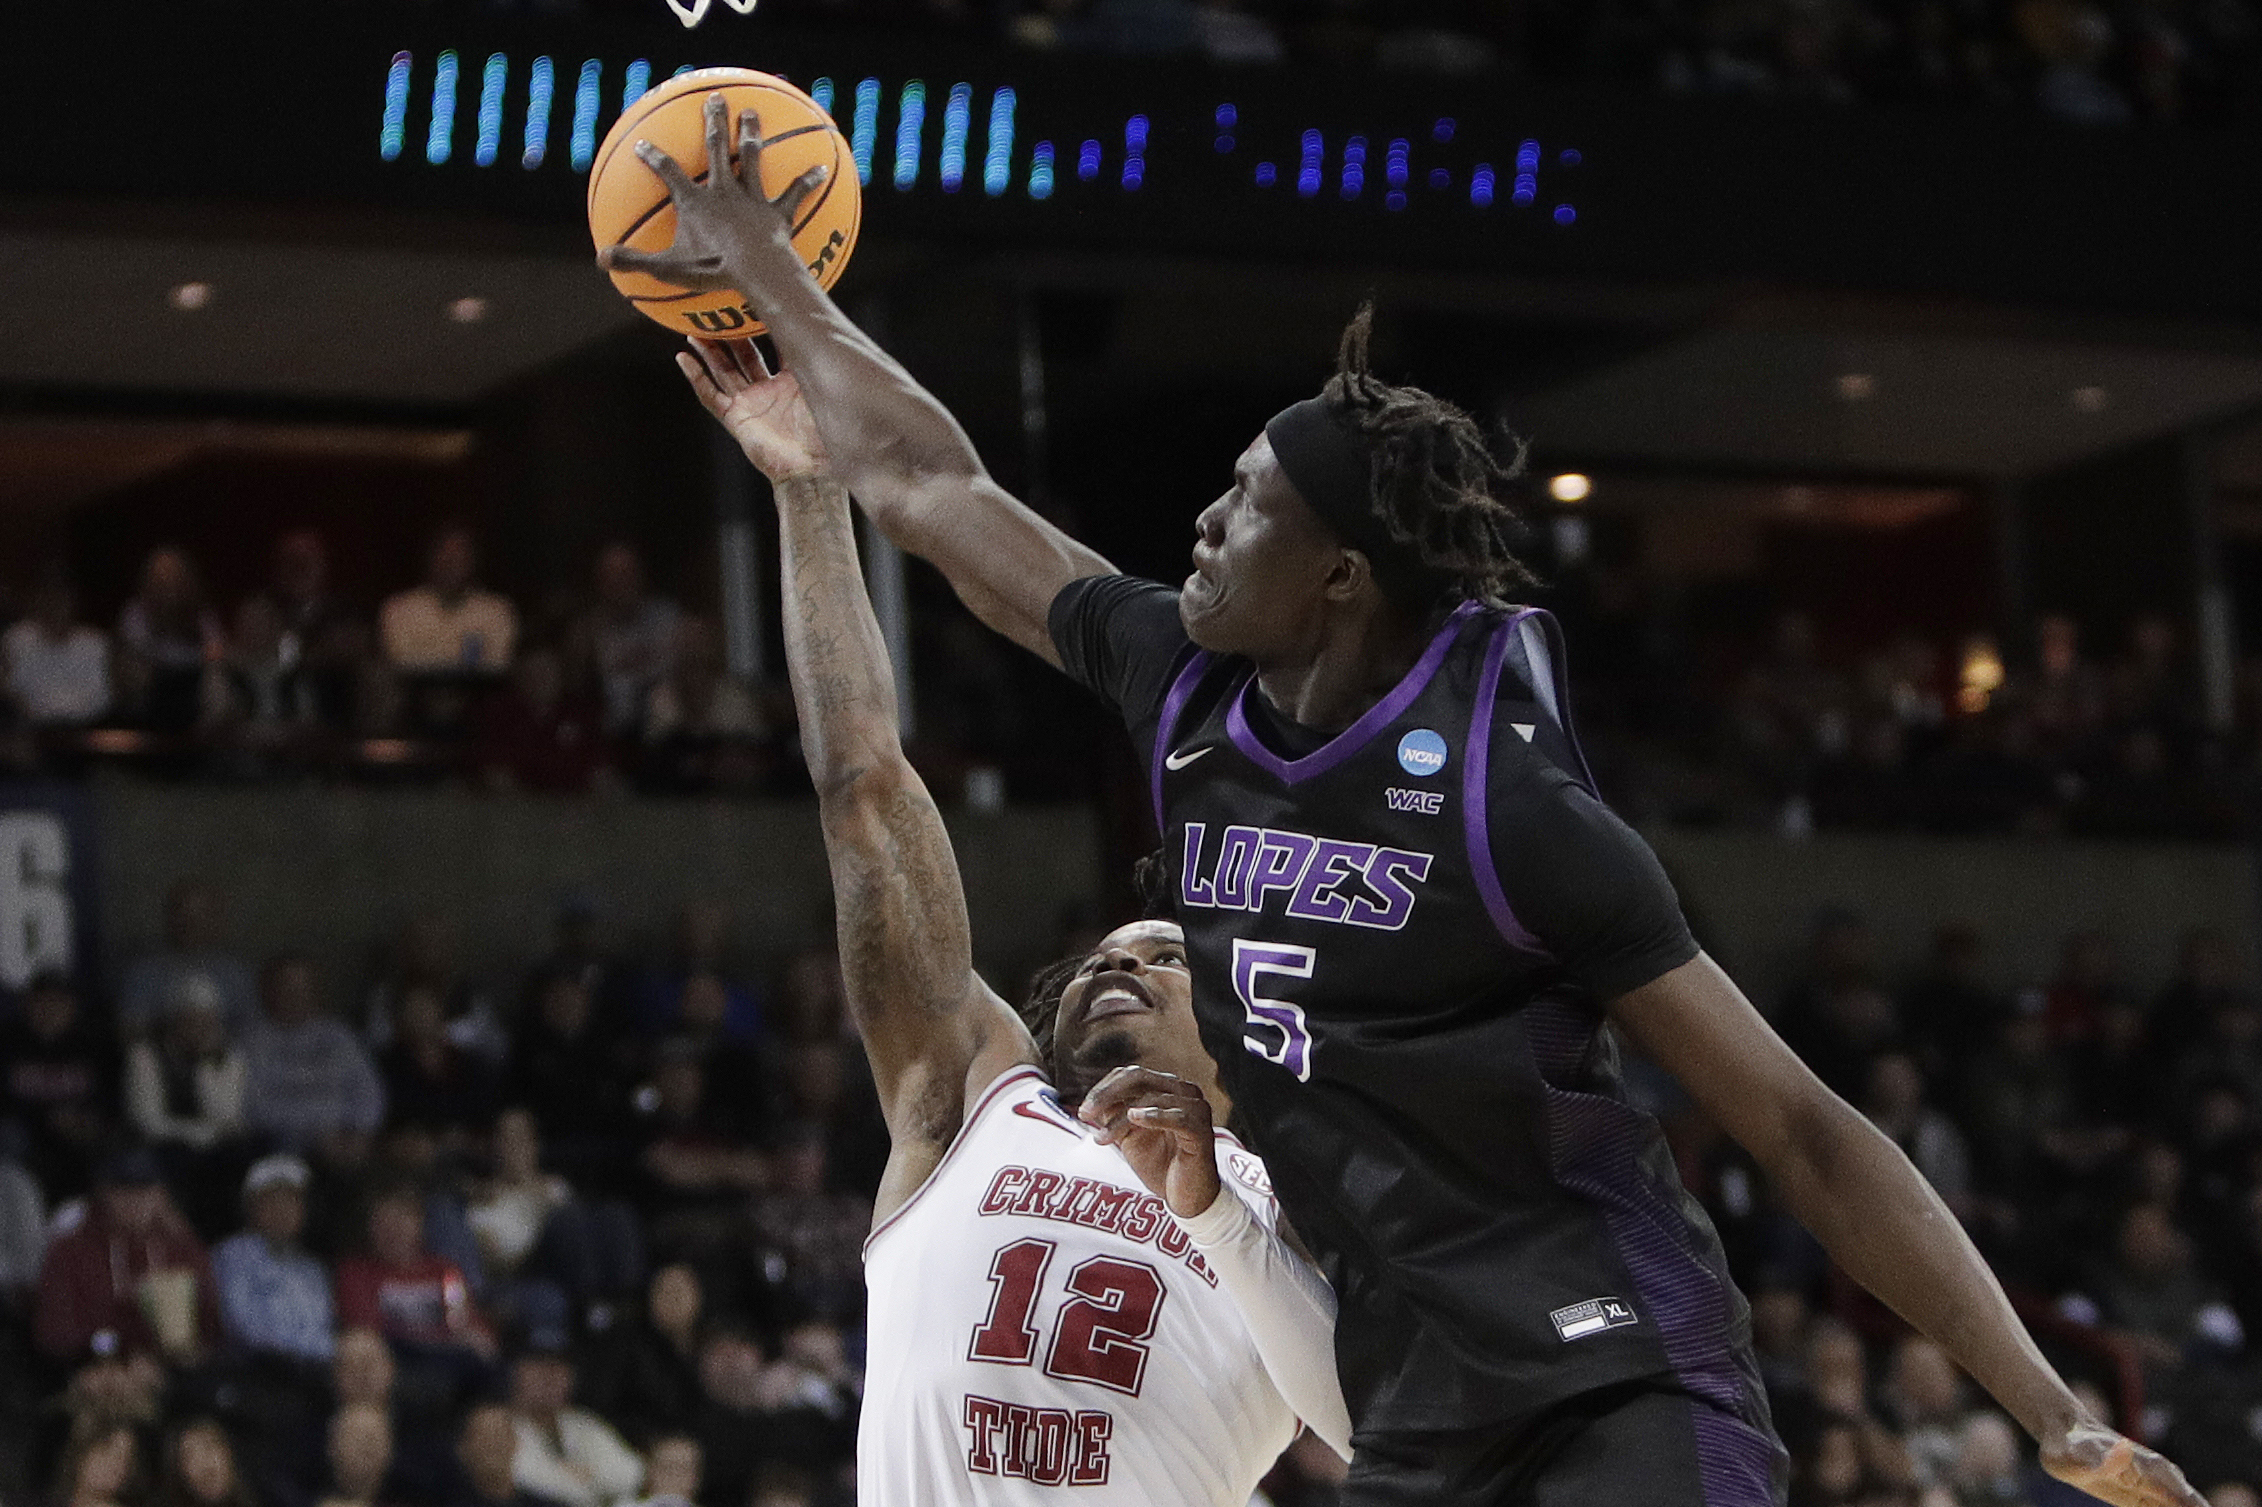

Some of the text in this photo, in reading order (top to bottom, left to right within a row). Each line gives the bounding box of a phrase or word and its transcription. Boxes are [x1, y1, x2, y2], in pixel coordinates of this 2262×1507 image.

[1403, 747, 1443, 767] NCAA
[1385, 787, 1445, 815] WAC
[1181, 822, 1434, 931] LOPES
[1231, 938, 1316, 1083] 5
[1231, 1155, 1272, 1191] SEC
[967, 1237, 1168, 1399] 12
[1605, 1304, 1628, 1318] XL
[964, 1393, 1112, 1486] TIDE
